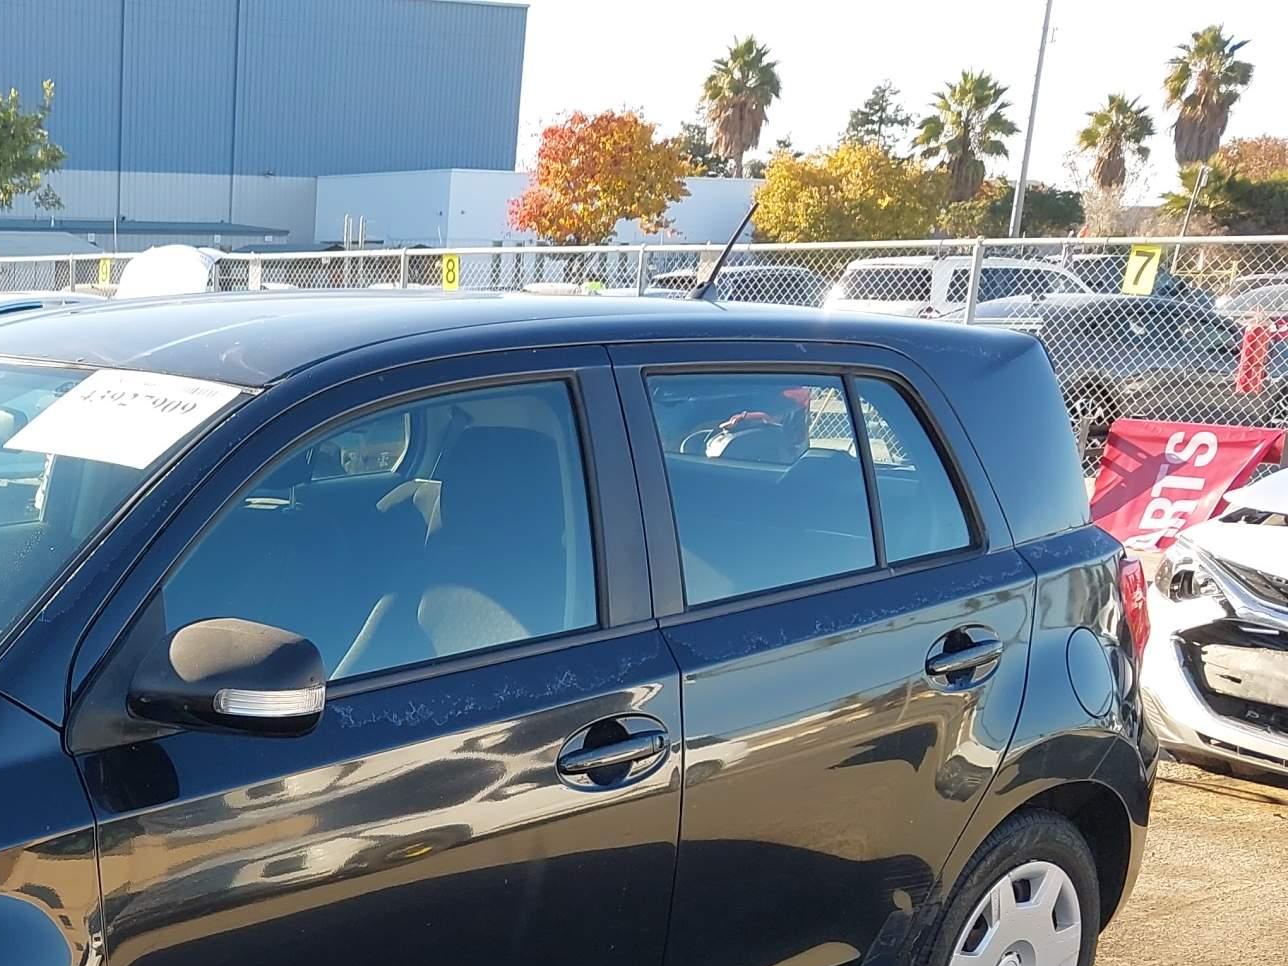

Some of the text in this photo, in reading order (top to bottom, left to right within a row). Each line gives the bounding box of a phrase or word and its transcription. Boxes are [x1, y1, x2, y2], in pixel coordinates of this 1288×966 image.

[101, 262, 108, 282] 9
[446, 258, 456, 284] 8
[1133, 250, 1156, 286] 7
